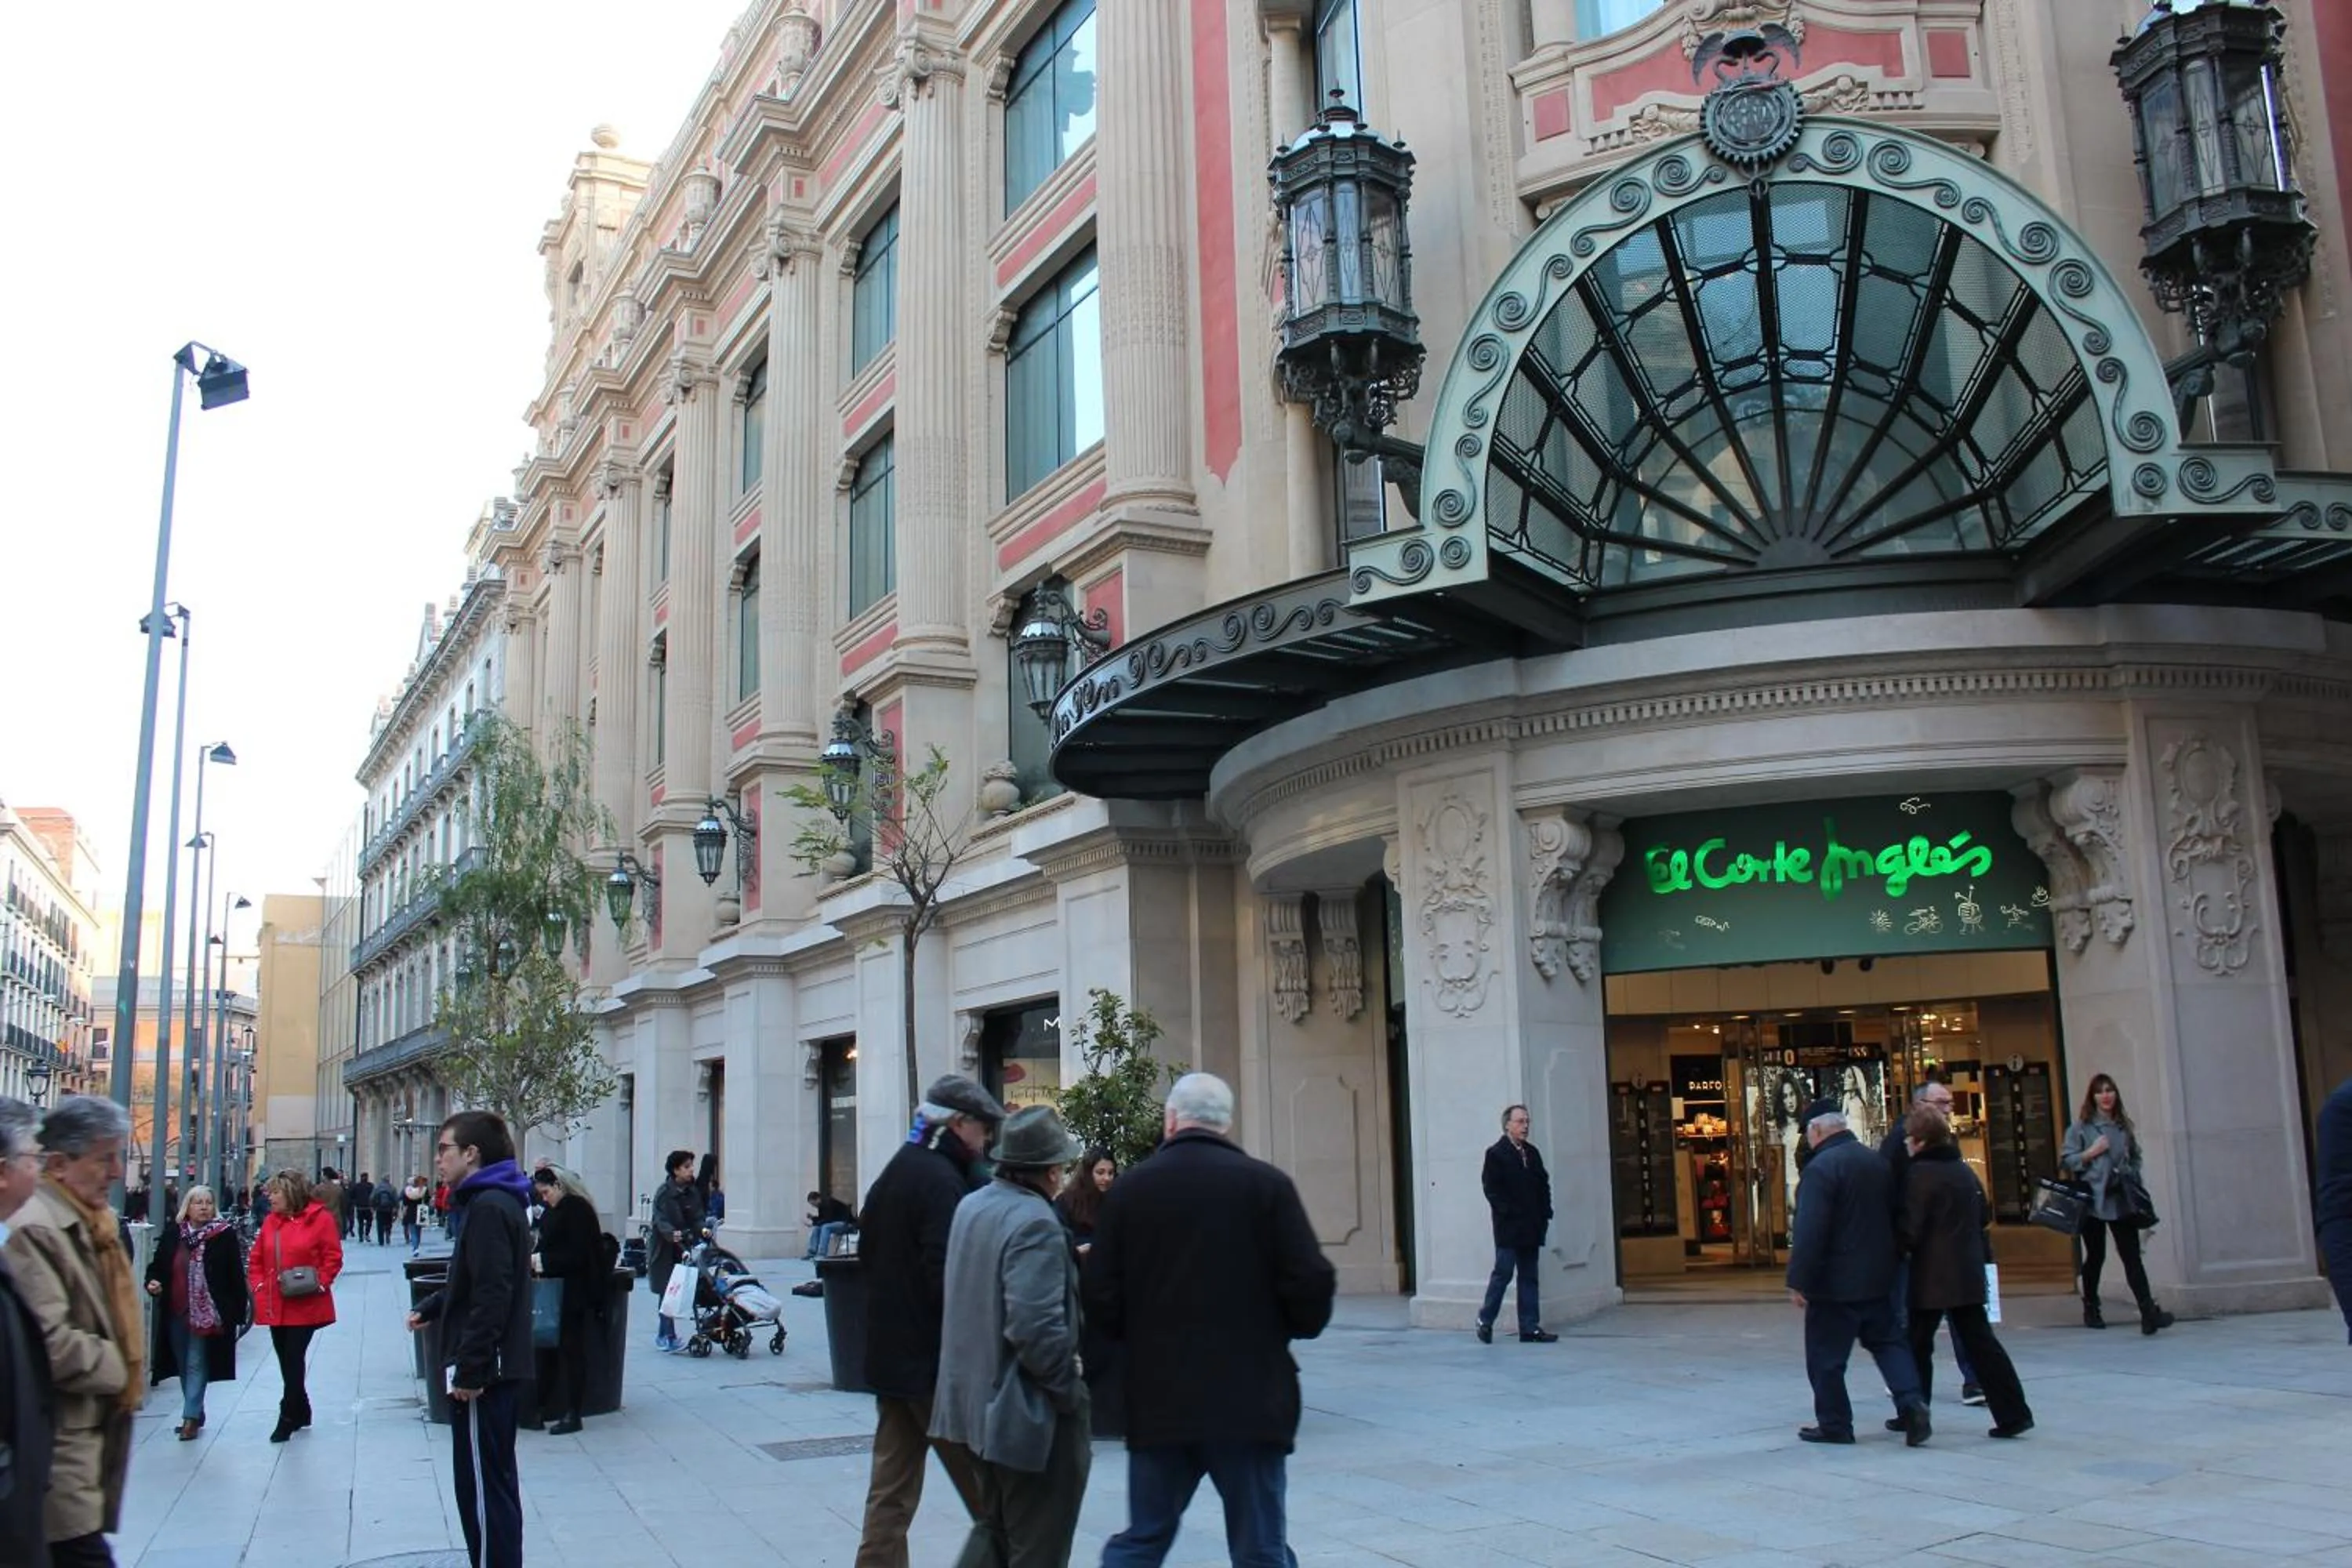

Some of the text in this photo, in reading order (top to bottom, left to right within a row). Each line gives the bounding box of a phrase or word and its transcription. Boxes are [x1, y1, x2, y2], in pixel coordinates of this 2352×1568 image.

[1645, 817, 1992, 902] El Corte Inglés
